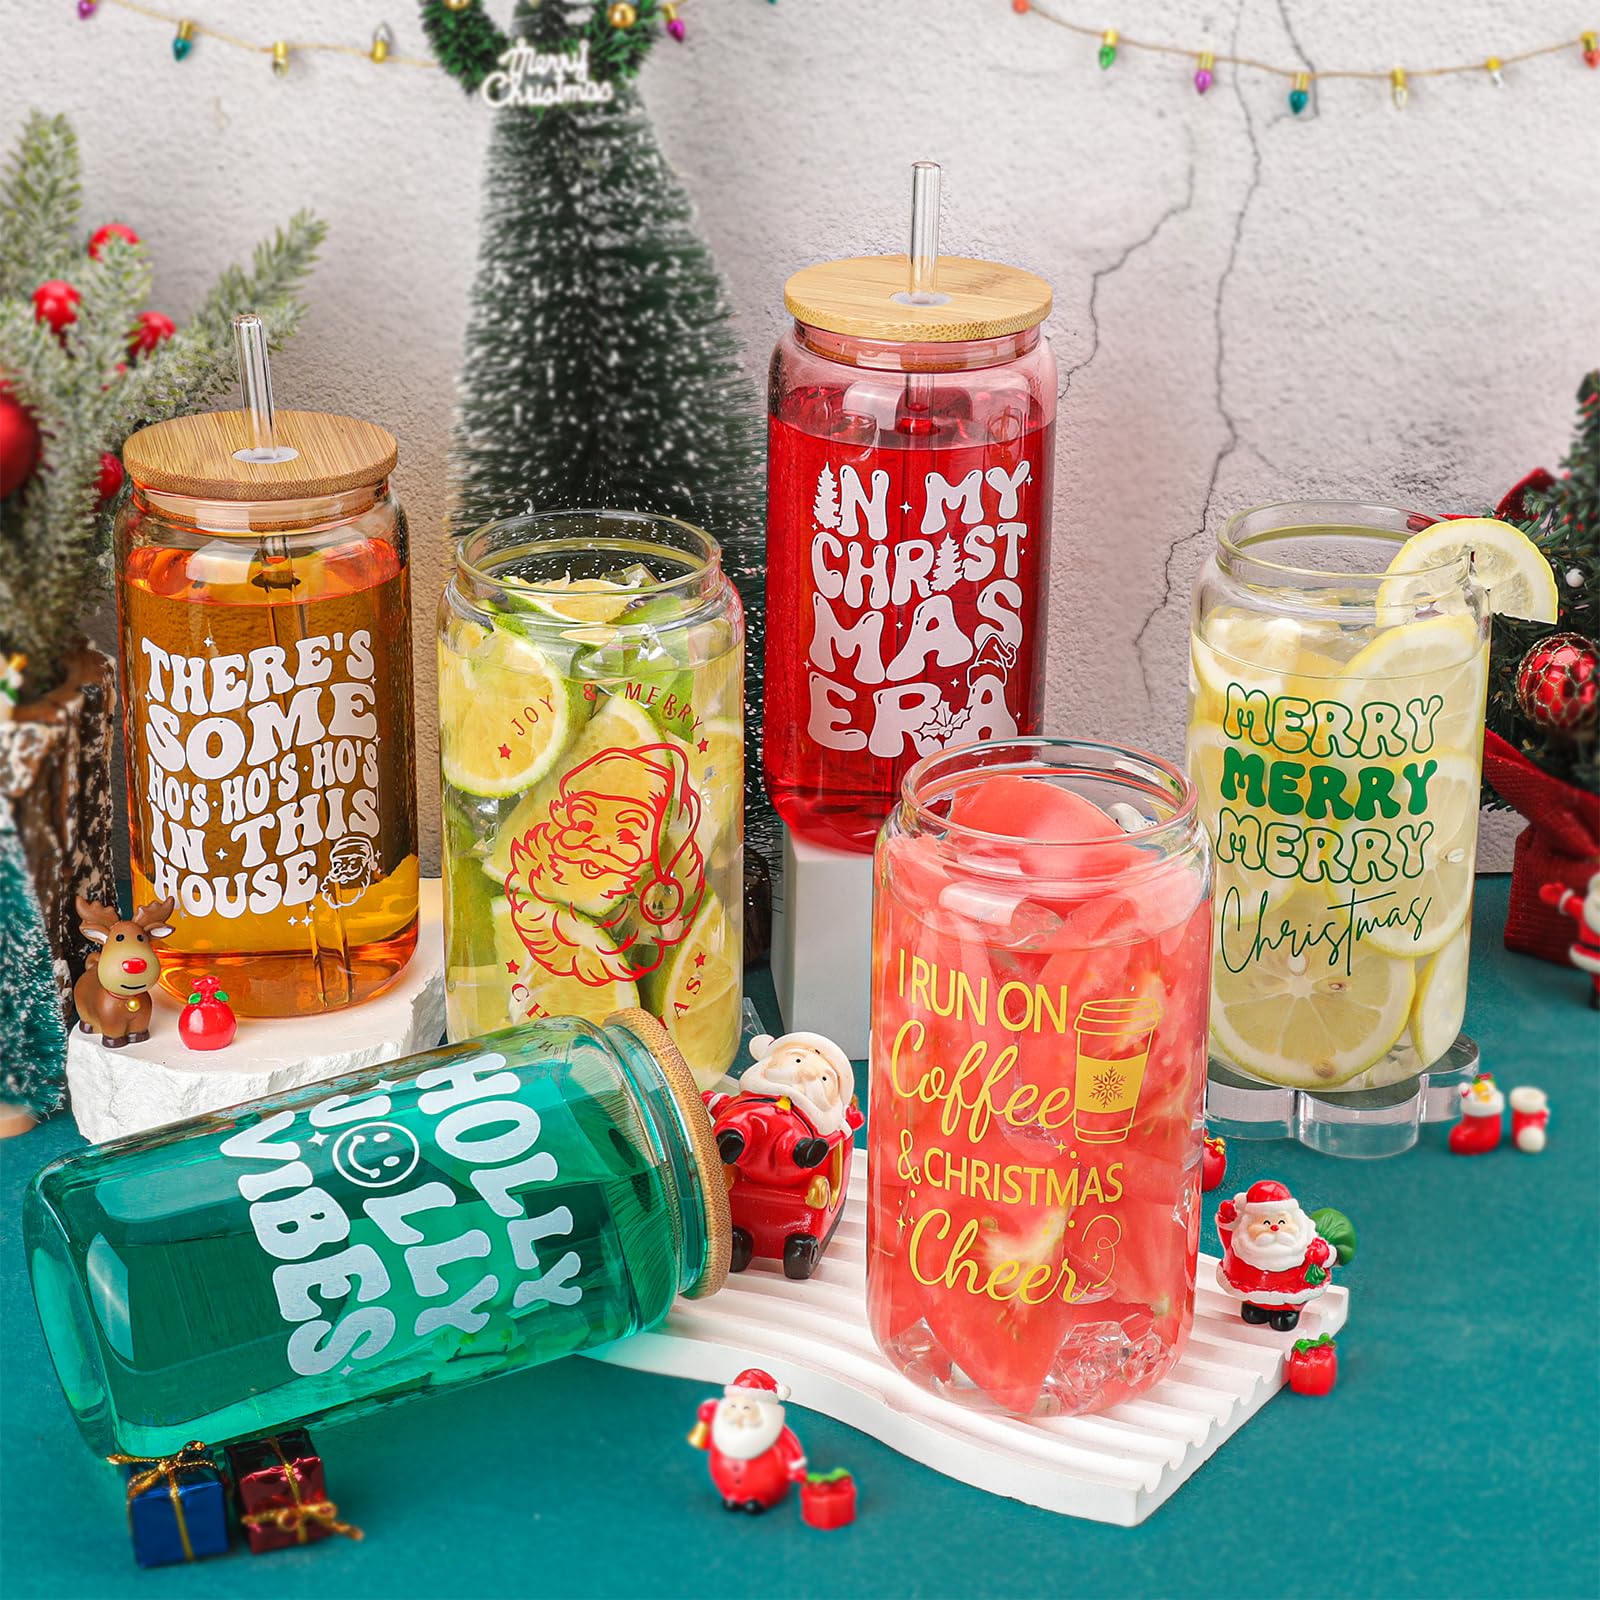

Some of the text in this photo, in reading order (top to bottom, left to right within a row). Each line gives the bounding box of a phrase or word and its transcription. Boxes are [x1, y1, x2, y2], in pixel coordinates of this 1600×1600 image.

[481, 71, 614, 108] Christmas
[497, 37, 590, 82] Merry
[921, 460, 1030, 535] MY
[141, 629, 375, 715] THERE'S
[809, 579, 1023, 684] MAS
[146, 682, 377, 780] SOME
[511, 682, 703, 737] JOY & MERRY
[808, 671, 1018, 758] ERA
[1223, 682, 1443, 759] MERRY
[148, 738, 379, 826] HO'S HO'S HO'S
[1220, 746, 1438, 821] MERRY
[150, 788, 380, 873] IN THIS
[1216, 807, 1434, 884] MERRY
[153, 850, 317, 918] HOUSE
[1221, 886, 1432, 976] Christmas
[899, 948, 1068, 1034] I RUN ON
[891, 1019, 1075, 1144] Coffee
[416, 1053, 583, 1309] HOLLY
[897, 1129, 1123, 1207] & CHRISTMAS
[219, 1110, 396, 1376] VIBES
[909, 1208, 1093, 1305] Cheer
